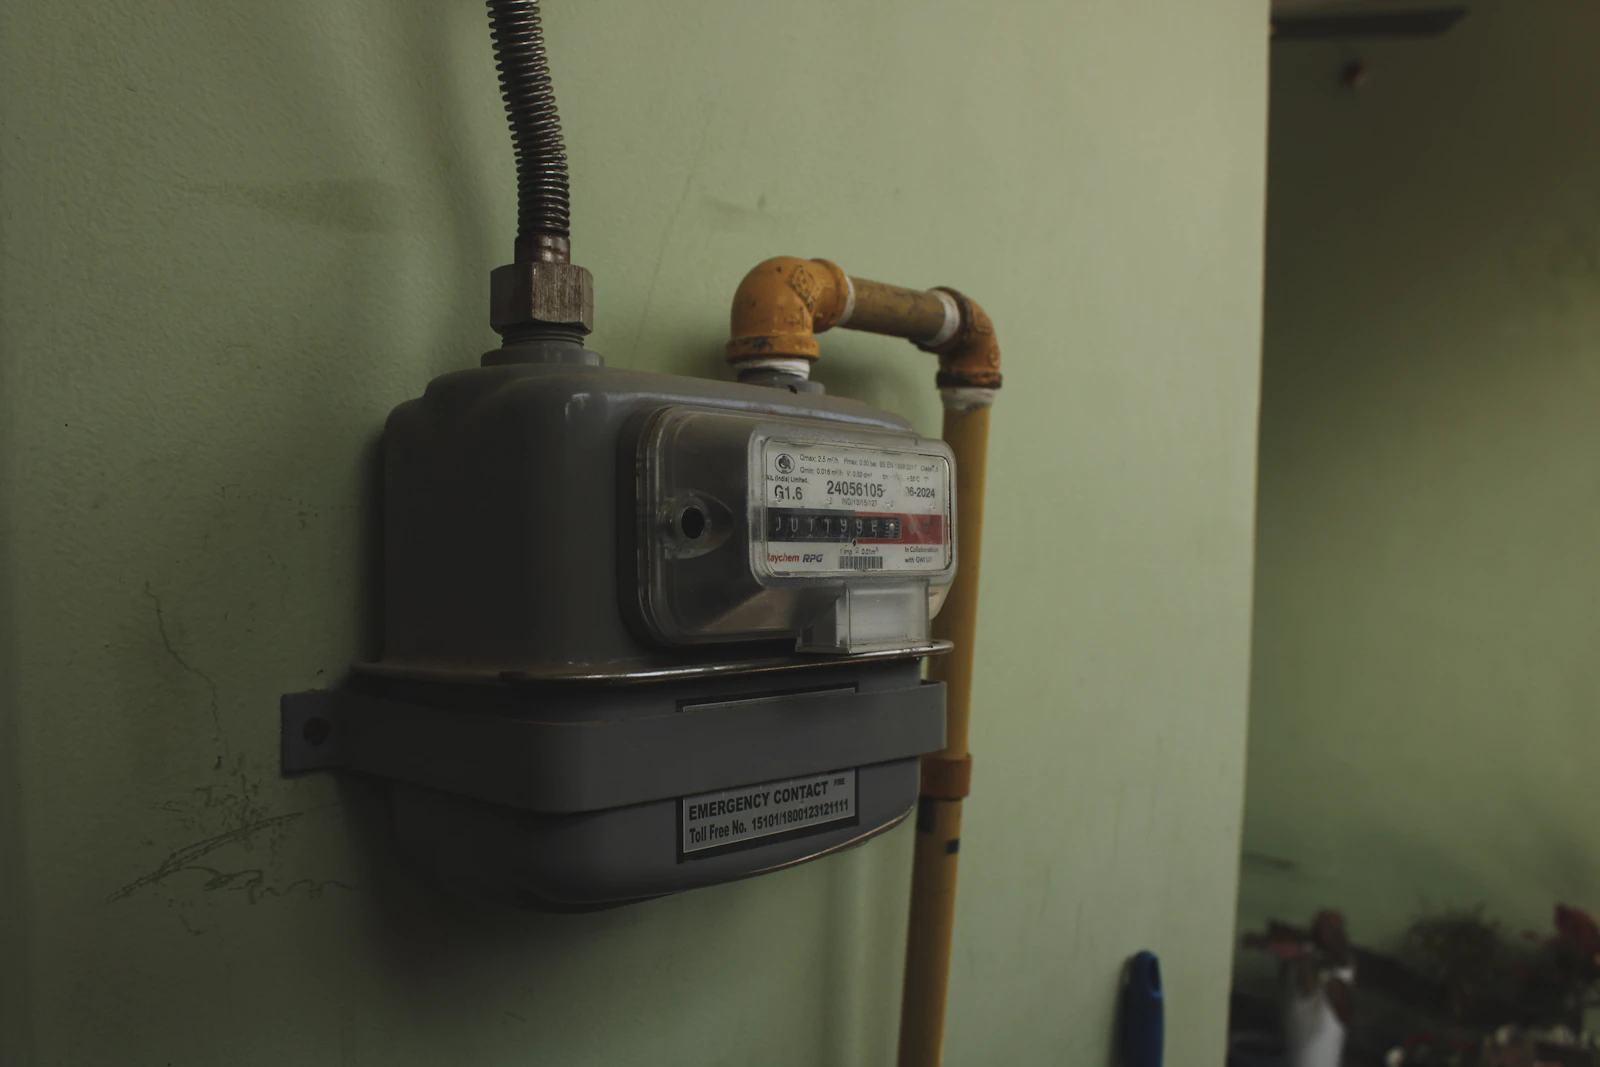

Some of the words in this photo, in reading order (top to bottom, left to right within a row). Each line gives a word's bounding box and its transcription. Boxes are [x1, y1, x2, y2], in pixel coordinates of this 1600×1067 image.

[774, 484, 803, 500] G1.6
[826, 480, 883, 498] 24056105
[802, 553, 823, 563] RPG
[833, 777, 846, 786] FIRE
[688, 791, 770, 821] EMERGENCY
[774, 781, 828, 804] CONTACT
[689, 823, 707, 844] Toll
[709, 822, 730, 841] Free
[732, 819, 747, 835] No.
[751, 798, 849, 831] 15101/1800123121111
